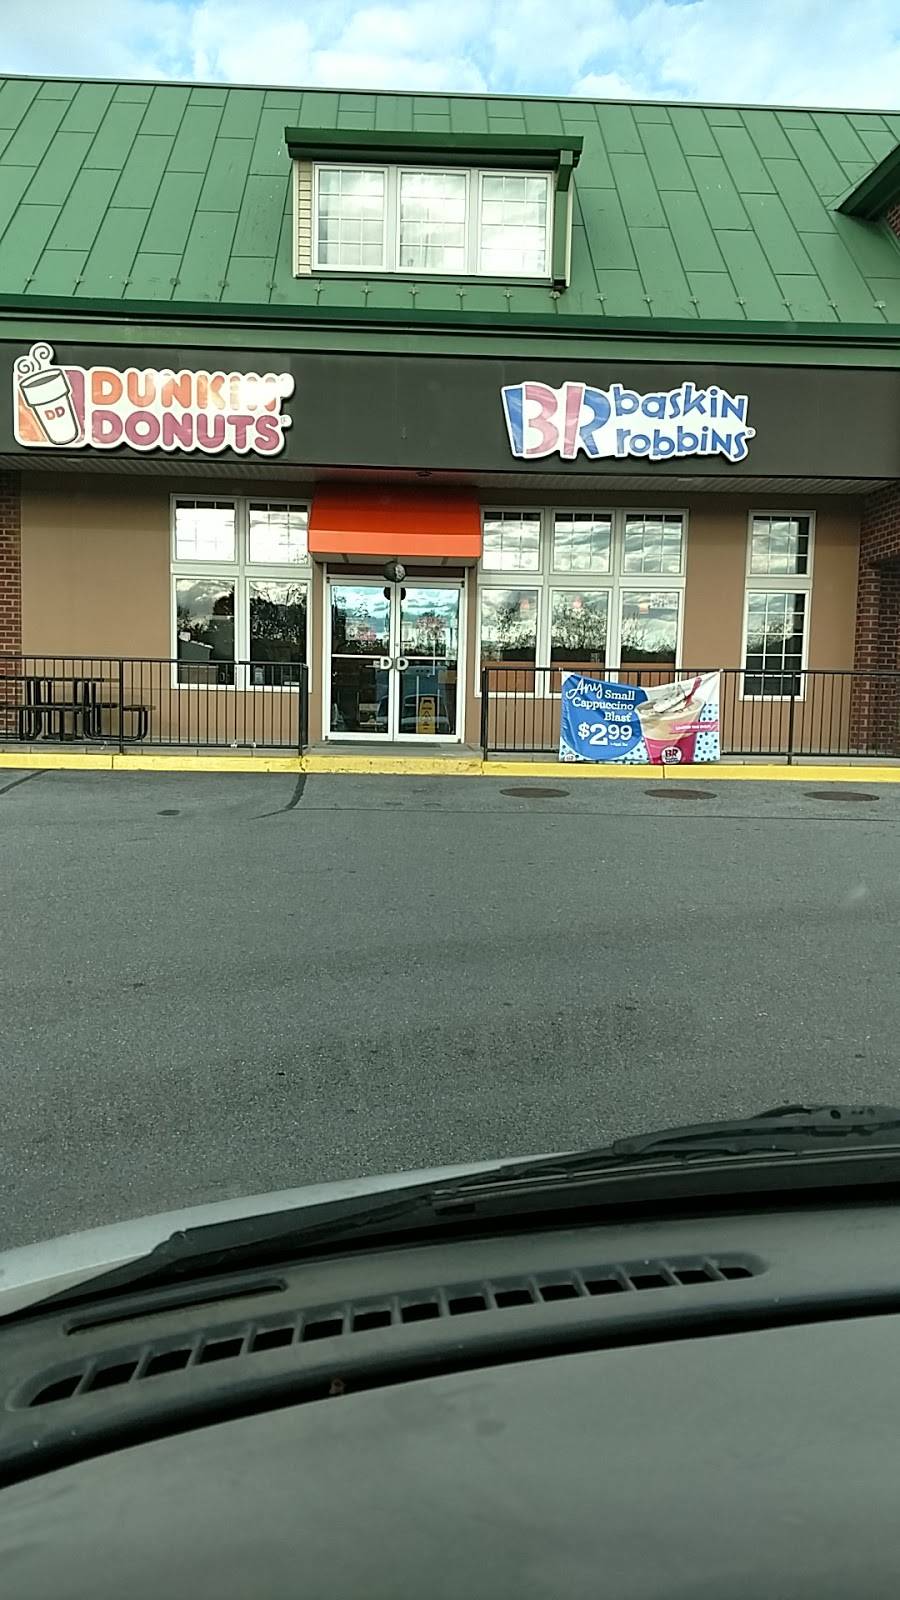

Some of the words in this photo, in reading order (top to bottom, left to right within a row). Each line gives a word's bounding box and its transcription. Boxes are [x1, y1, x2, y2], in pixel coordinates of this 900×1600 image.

[91, 370, 283, 412] DUNKI
[613, 384, 745, 422] baskin
[44, 406, 66, 420] DD
[91, 410, 279, 450] DONUTS
[504, 384, 611, 456] BR
[616, 425, 746, 459] robbins
[565, 678, 603, 699] Any
[604, 689, 635, 700] Small
[571, 698, 634, 711] Cappuccino
[603, 711, 632, 722] Blast
